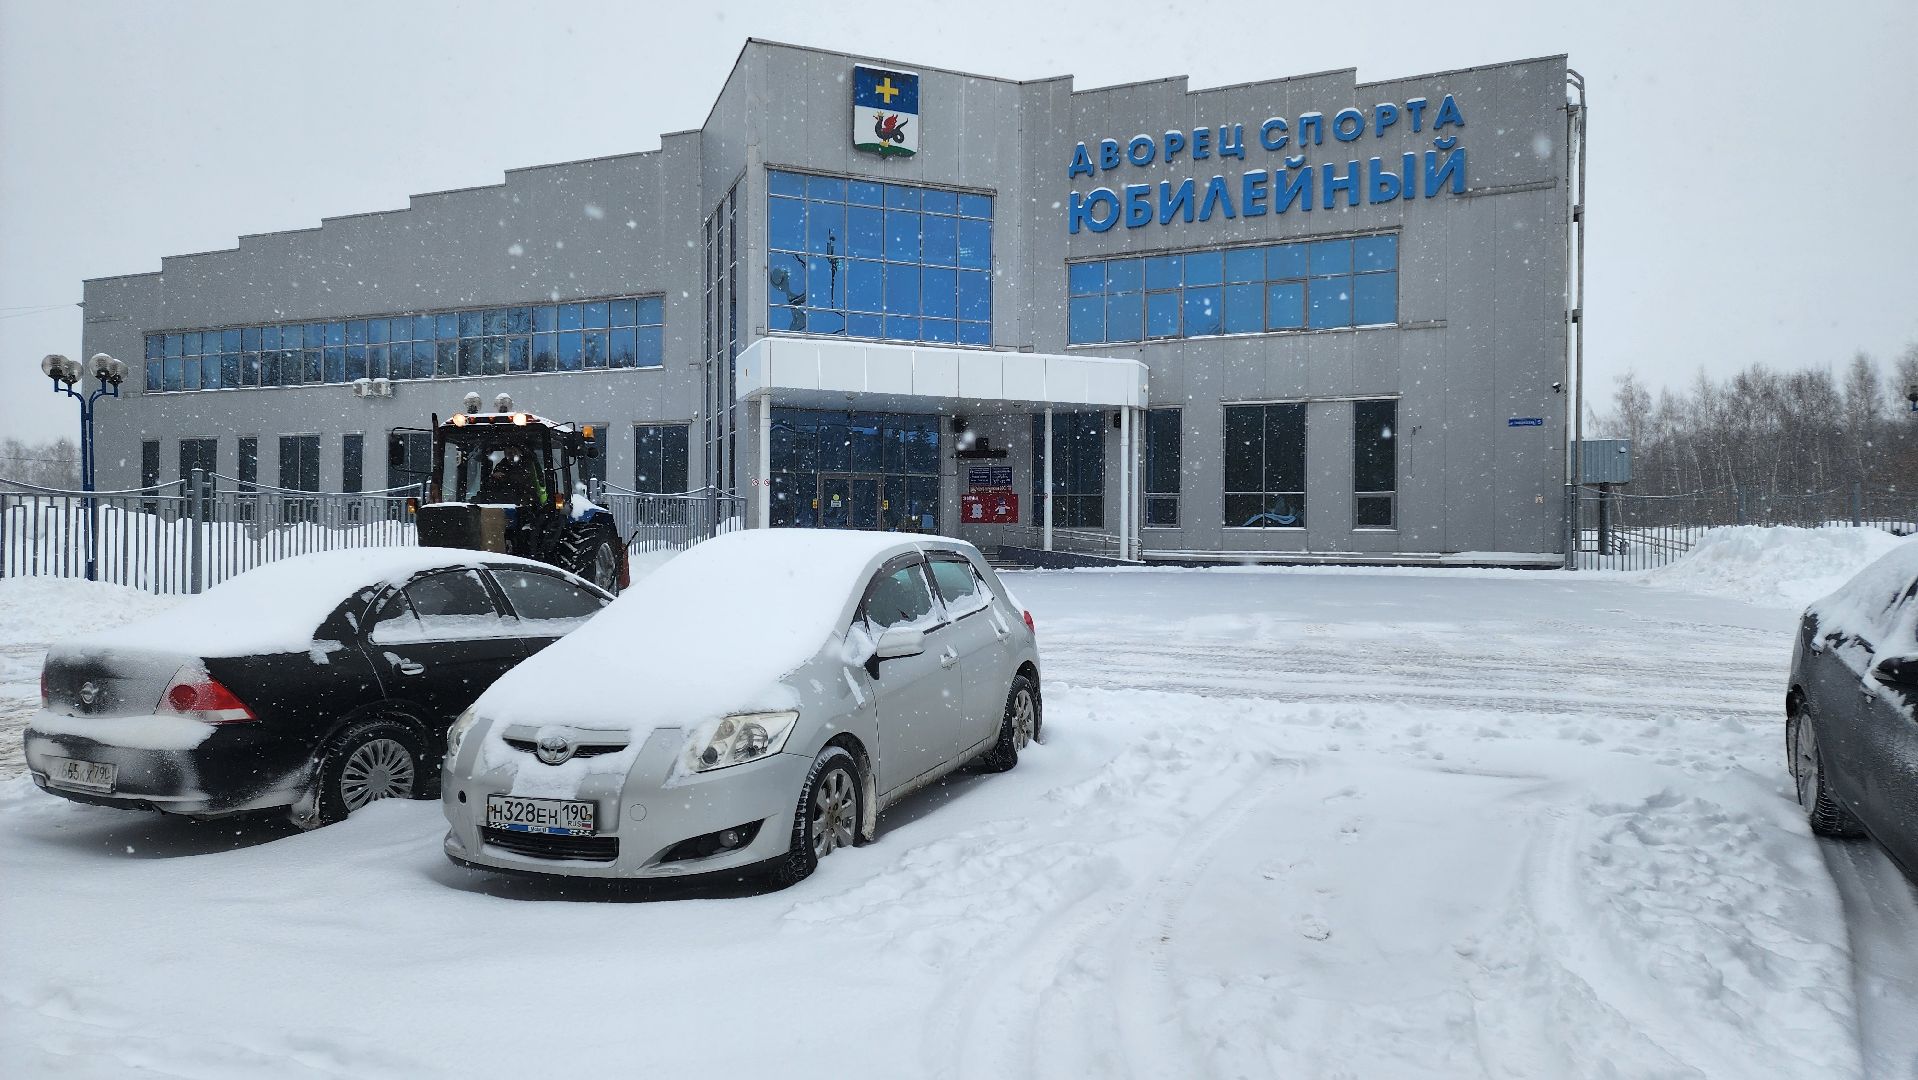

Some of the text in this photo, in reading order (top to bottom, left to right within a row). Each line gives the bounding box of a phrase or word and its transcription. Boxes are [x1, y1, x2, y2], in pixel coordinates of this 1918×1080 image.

[1068, 94, 1465, 179] ДВОРЕЦ СПОРТА
[1068, 135, 1467, 235] ЮБИЛЕЙНЫЙ
[493, 800, 589, 825] Н328ЕН 190
[567, 820, 582, 828] RUS
